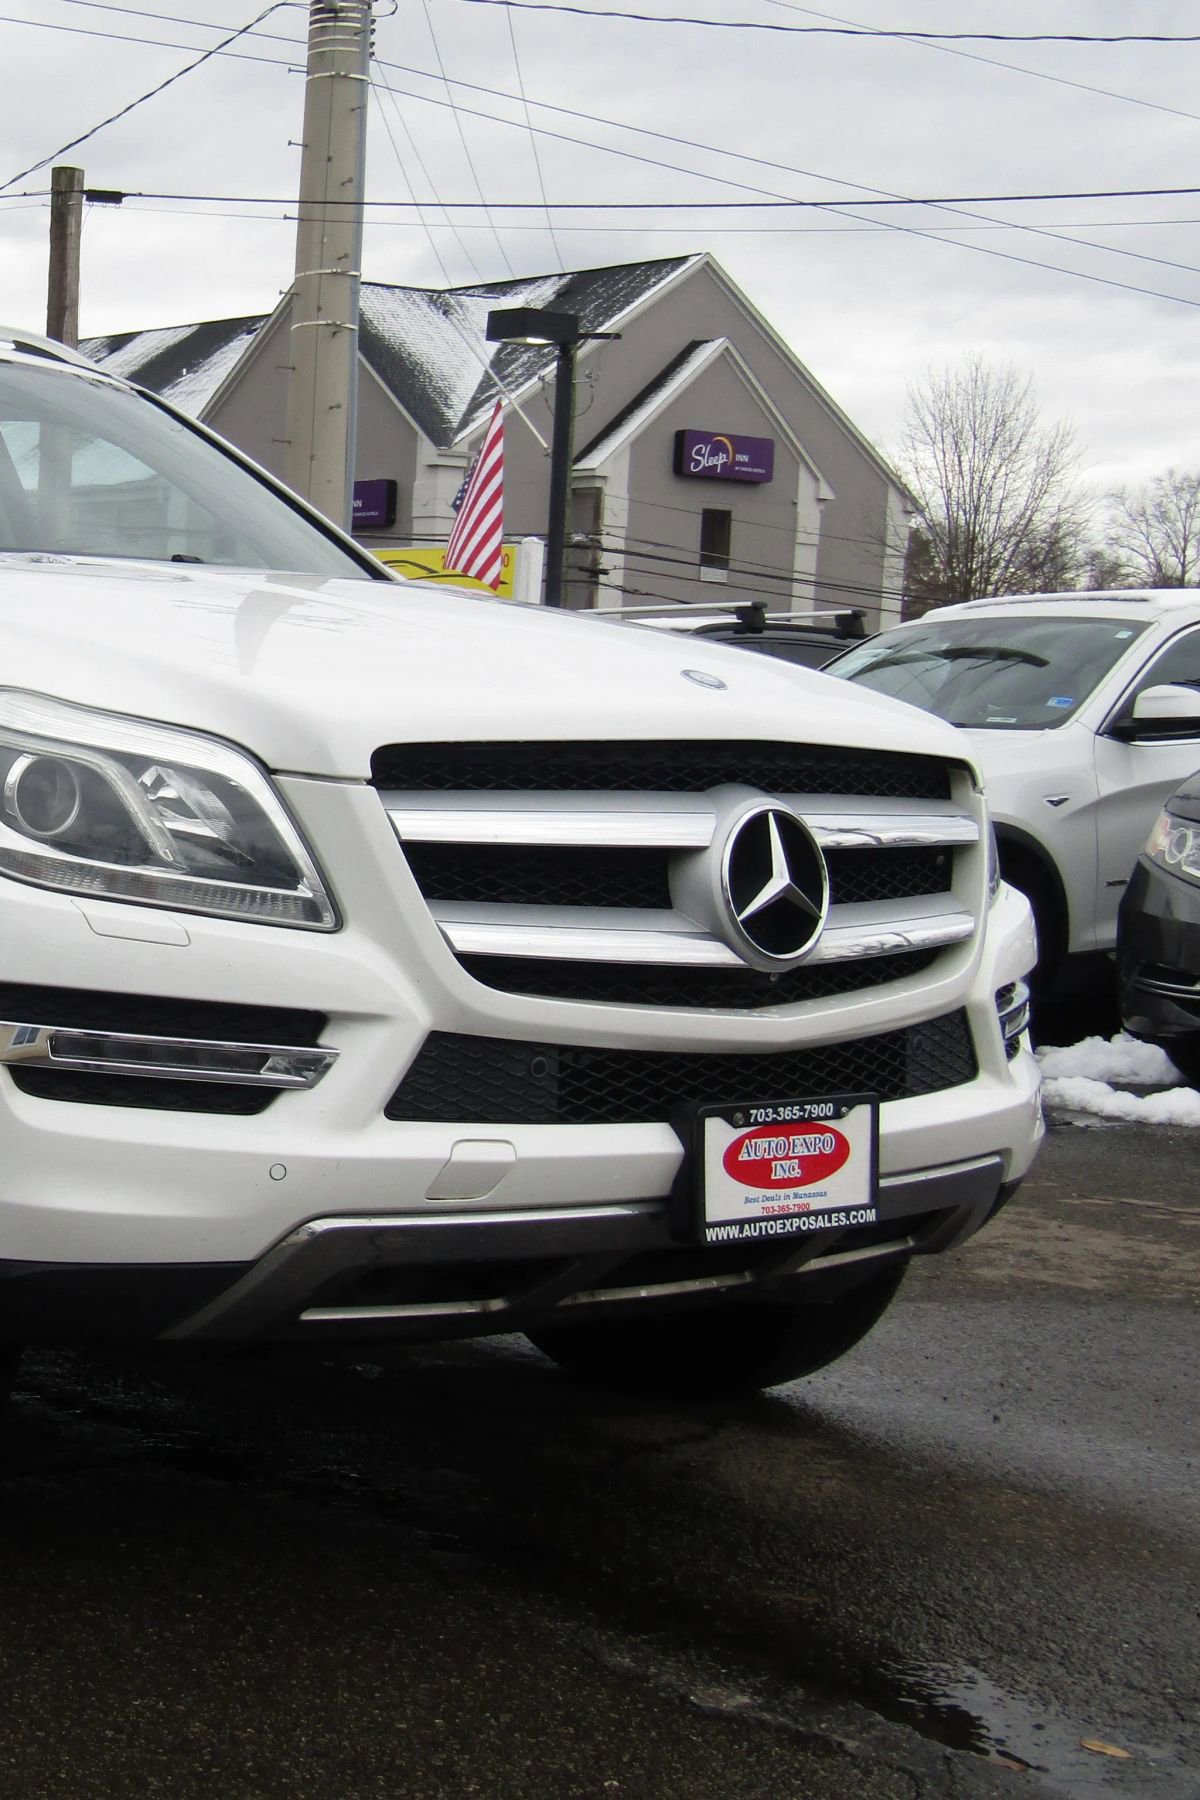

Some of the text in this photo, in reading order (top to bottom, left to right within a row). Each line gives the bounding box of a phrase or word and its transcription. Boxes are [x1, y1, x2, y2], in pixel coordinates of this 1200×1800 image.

[690, 443, 729, 473] Sleep
[735, 453, 749, 463] INN
[749, 1102, 834, 1123] 703-365-7900
[738, 1133, 835, 1161] AUTO EXPO
[771, 1159, 801, 1179] INC.
[744, 1190, 828, 1204] Best Deals in Manassas
[760, 1202, 811, 1215] 703-365-7900
[705, 1208, 877, 1242] WWW.AUTOEXPOSALES.COM
